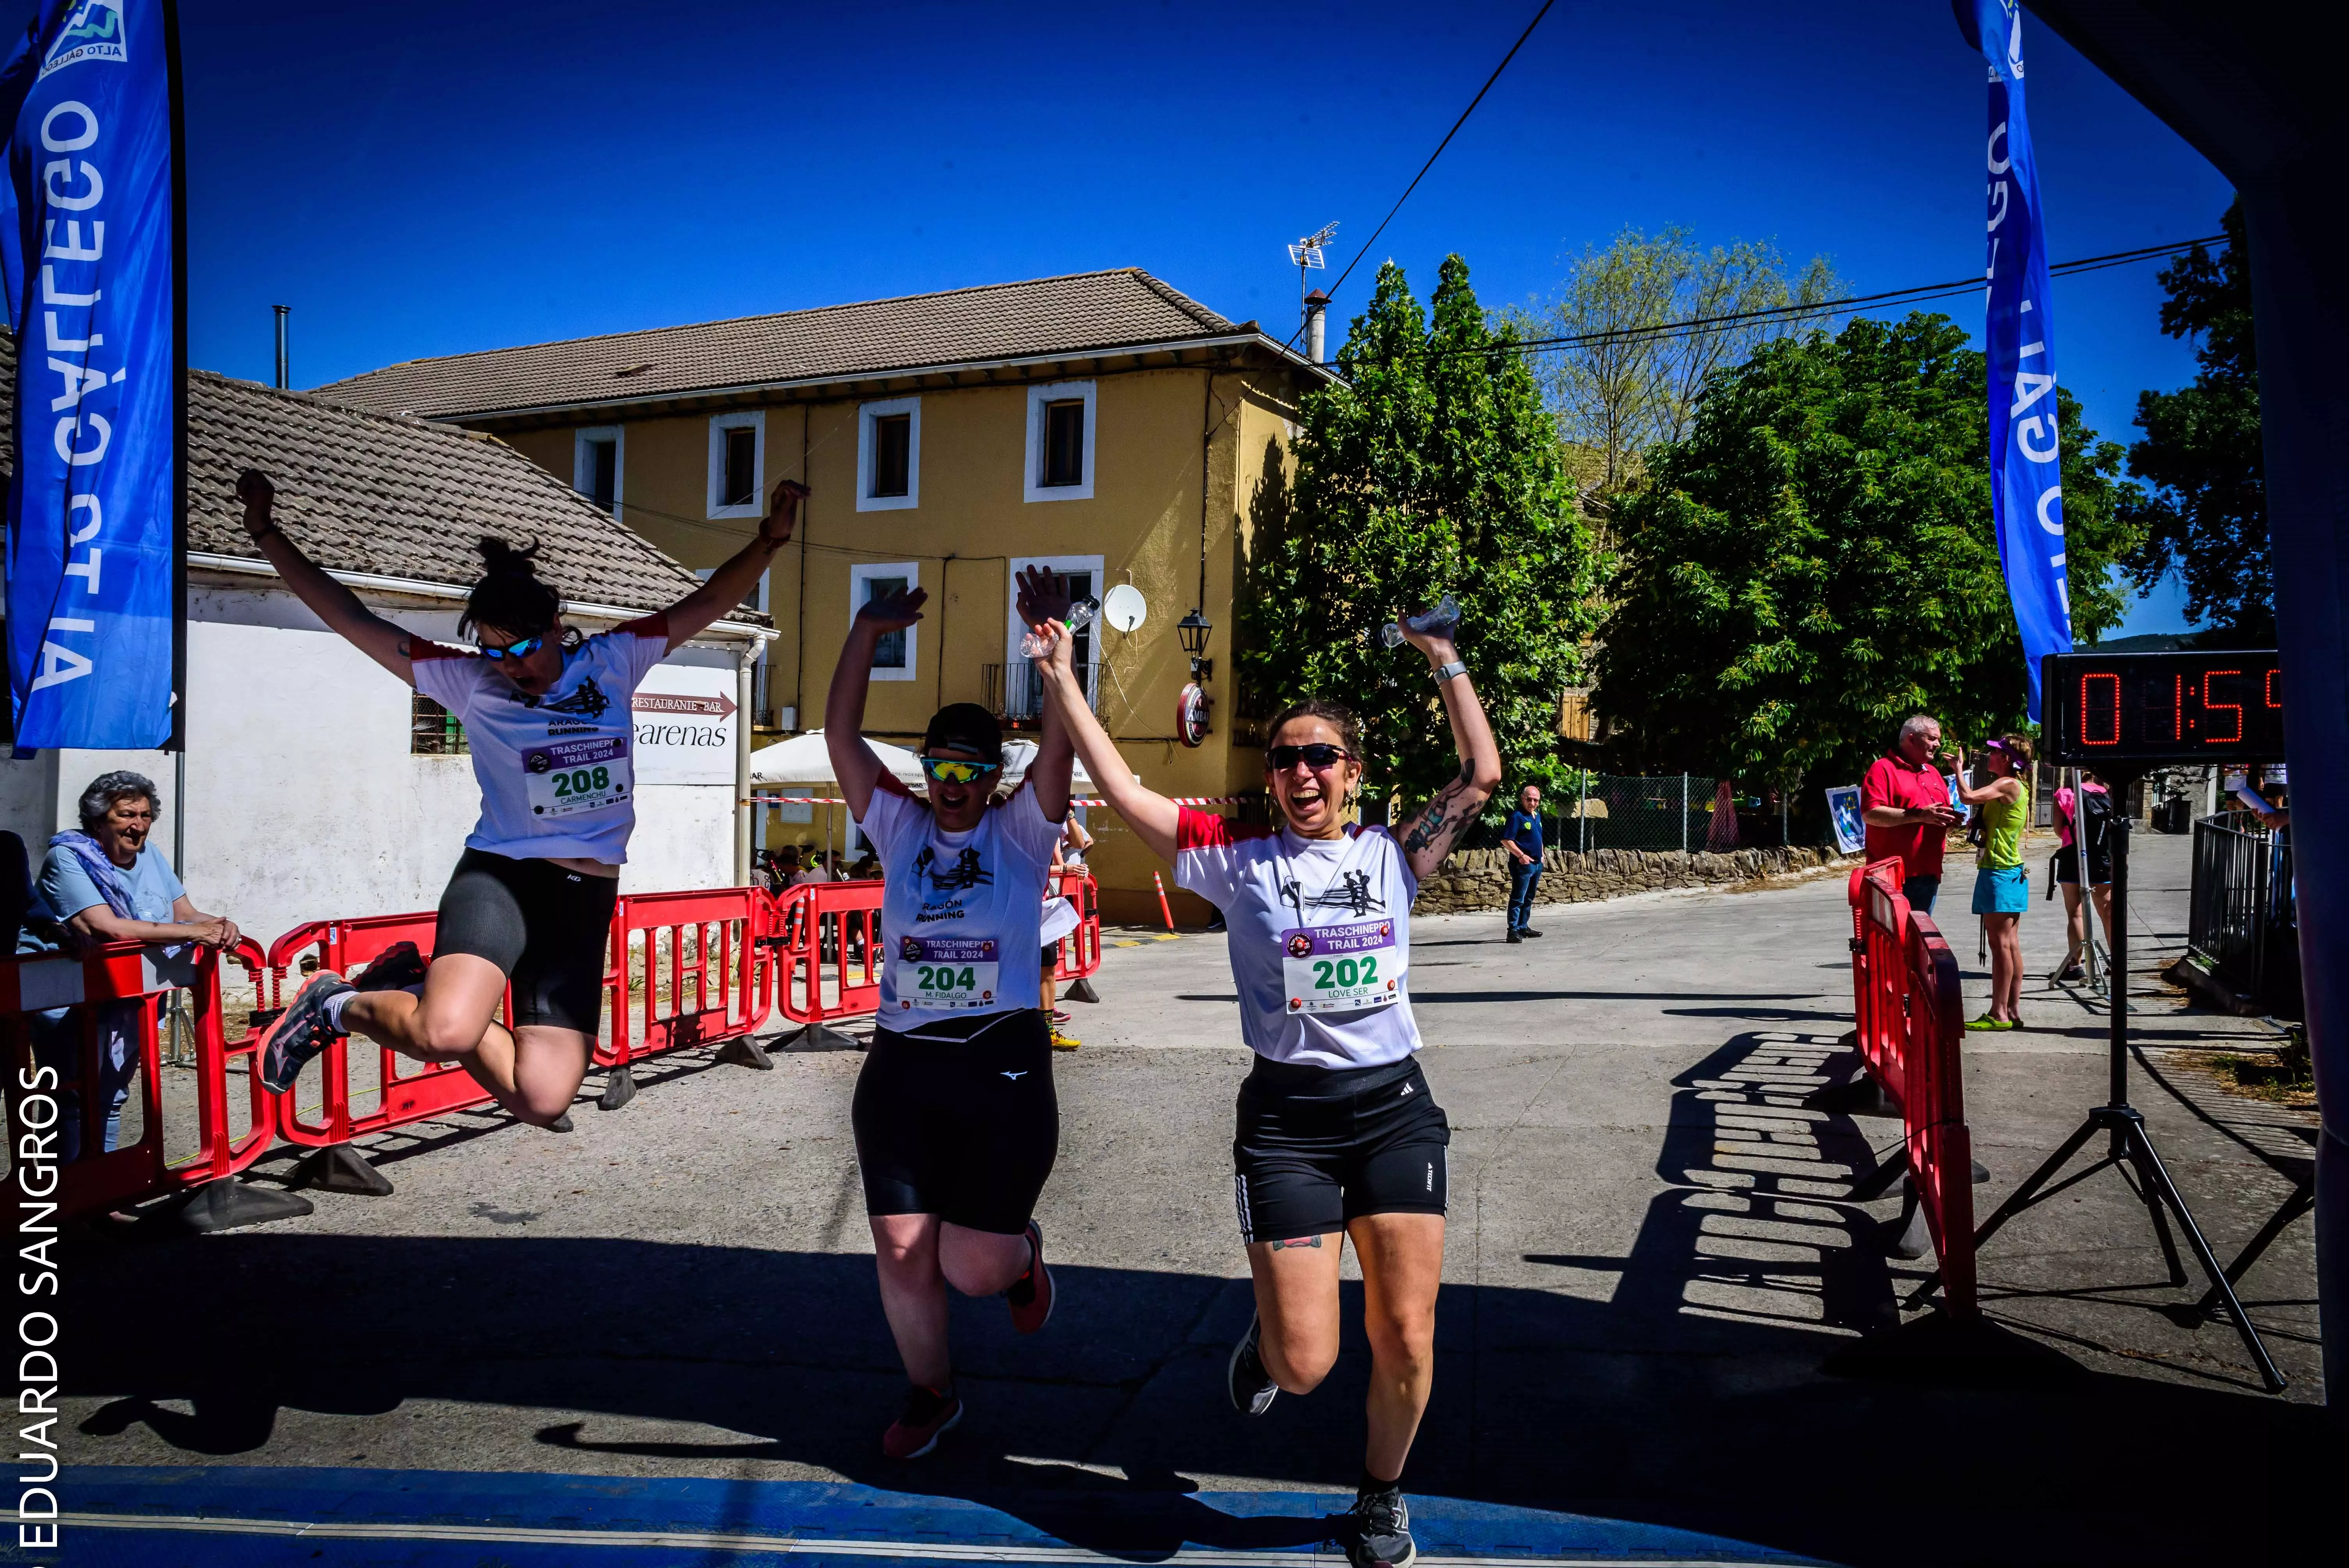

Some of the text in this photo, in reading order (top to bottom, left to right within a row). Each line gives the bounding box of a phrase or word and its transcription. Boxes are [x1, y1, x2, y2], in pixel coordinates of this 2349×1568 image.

[563, 748, 613, 764] TRAIL 2024
[552, 766, 610, 798] 208
[561, 791, 606, 804] CARMENCHU
[916, 910, 964, 922] RUNNING
[1328, 935, 1383, 950] TRAIL 2024
[918, 966, 976, 991] 204
[1313, 956, 1378, 989] 202
[1329, 987, 1368, 998] LOVE SER
